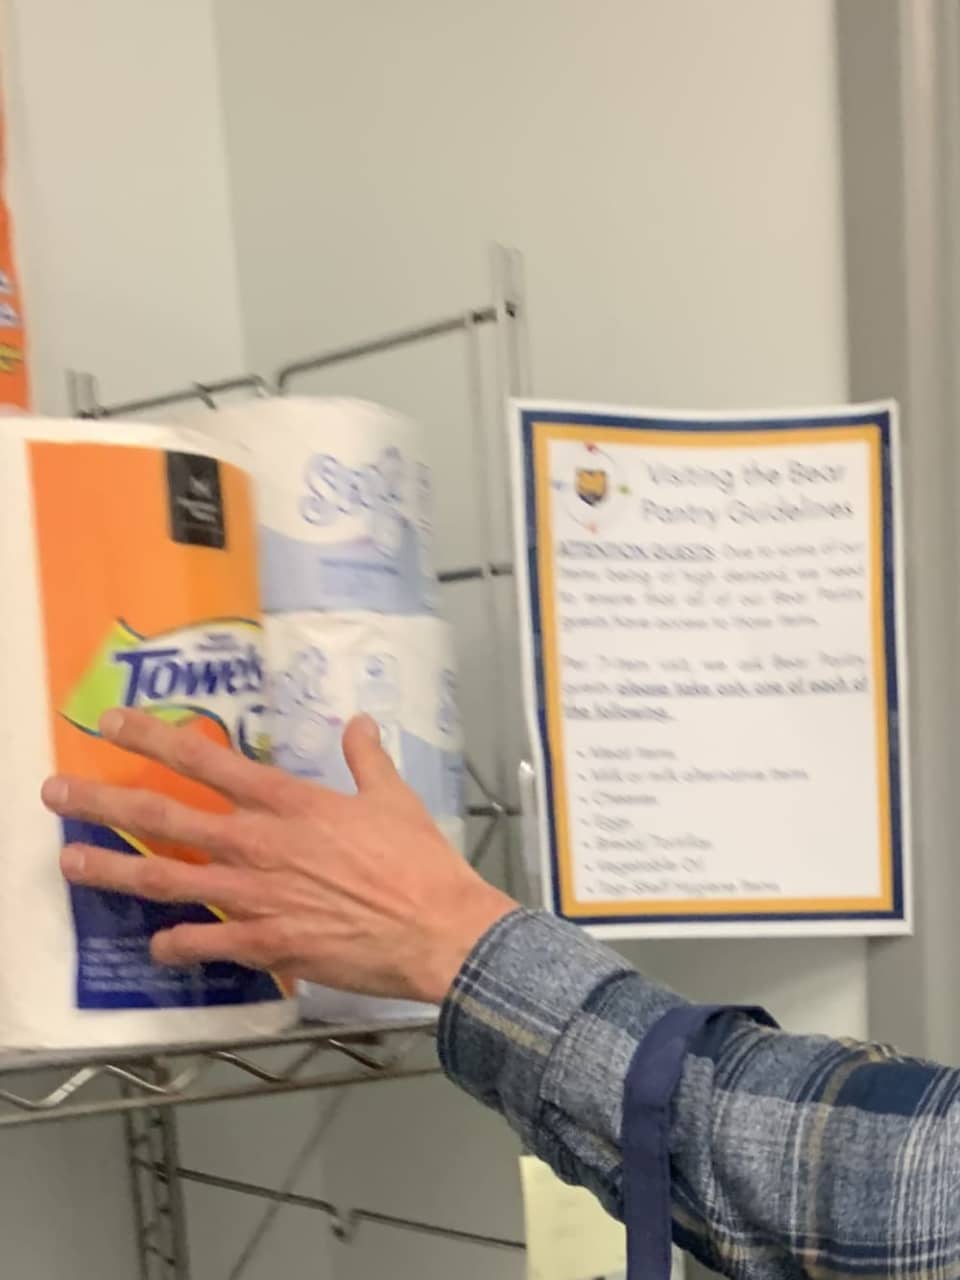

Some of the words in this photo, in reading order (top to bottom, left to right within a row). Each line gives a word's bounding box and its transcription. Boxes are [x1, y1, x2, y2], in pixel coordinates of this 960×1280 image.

[741, 460, 781, 487] the
[787, 458, 846, 486] Bear
[641, 498, 717, 532] Pantry
[726, 495, 855, 526] Guidelines
